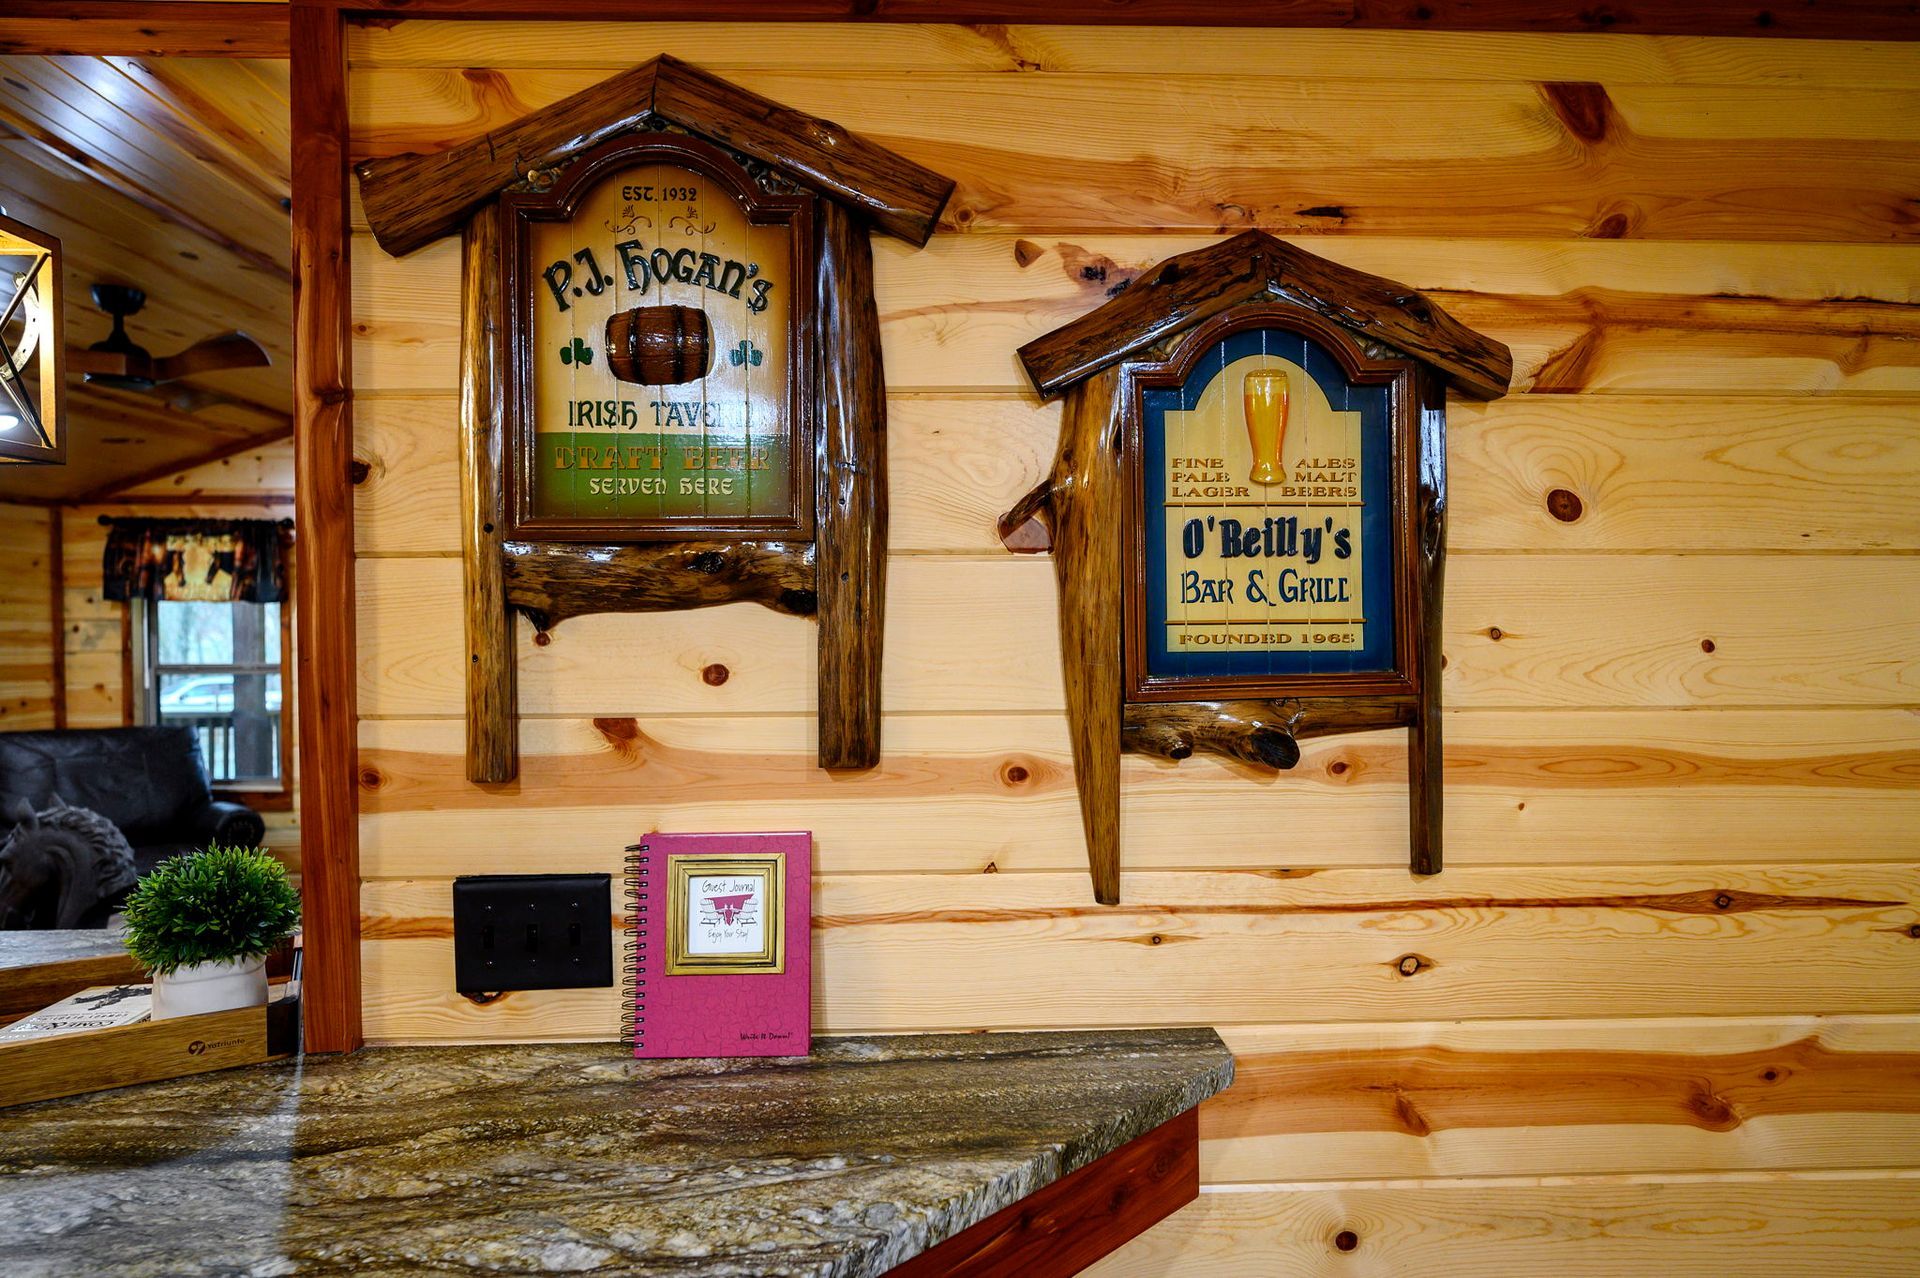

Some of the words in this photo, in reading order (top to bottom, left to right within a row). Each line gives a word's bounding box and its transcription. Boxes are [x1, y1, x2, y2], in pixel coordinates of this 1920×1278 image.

[622, 185, 658, 202] EST.
[662, 187, 697, 202] 1932
[542, 247, 614, 312] P.J.
[568, 400, 638, 429] IRISH
[554, 446, 669, 470] DRAFT
[682, 446, 770, 470] BEER
[1171, 457, 1224, 469] FINE
[1296, 457, 1356, 469] ALES
[1171, 471, 1230, 482] PALE
[1294, 471, 1357, 482] MALT
[679, 477, 734, 495] HERE
[1171, 486, 1250, 497] LAGER
[1281, 486, 1357, 497] BEERS
[1182, 514, 1352, 565] O'Reilly's
[1180, 569, 1234, 604] BAR
[1246, 569, 1277, 606] &
[1278, 568, 1350, 604] GRILL
[1179, 633, 1292, 645] FOUNDED
[1301, 633, 1355, 644] 1965
[702, 879, 727, 894] Guest
[729, 879, 756, 893] Journal
